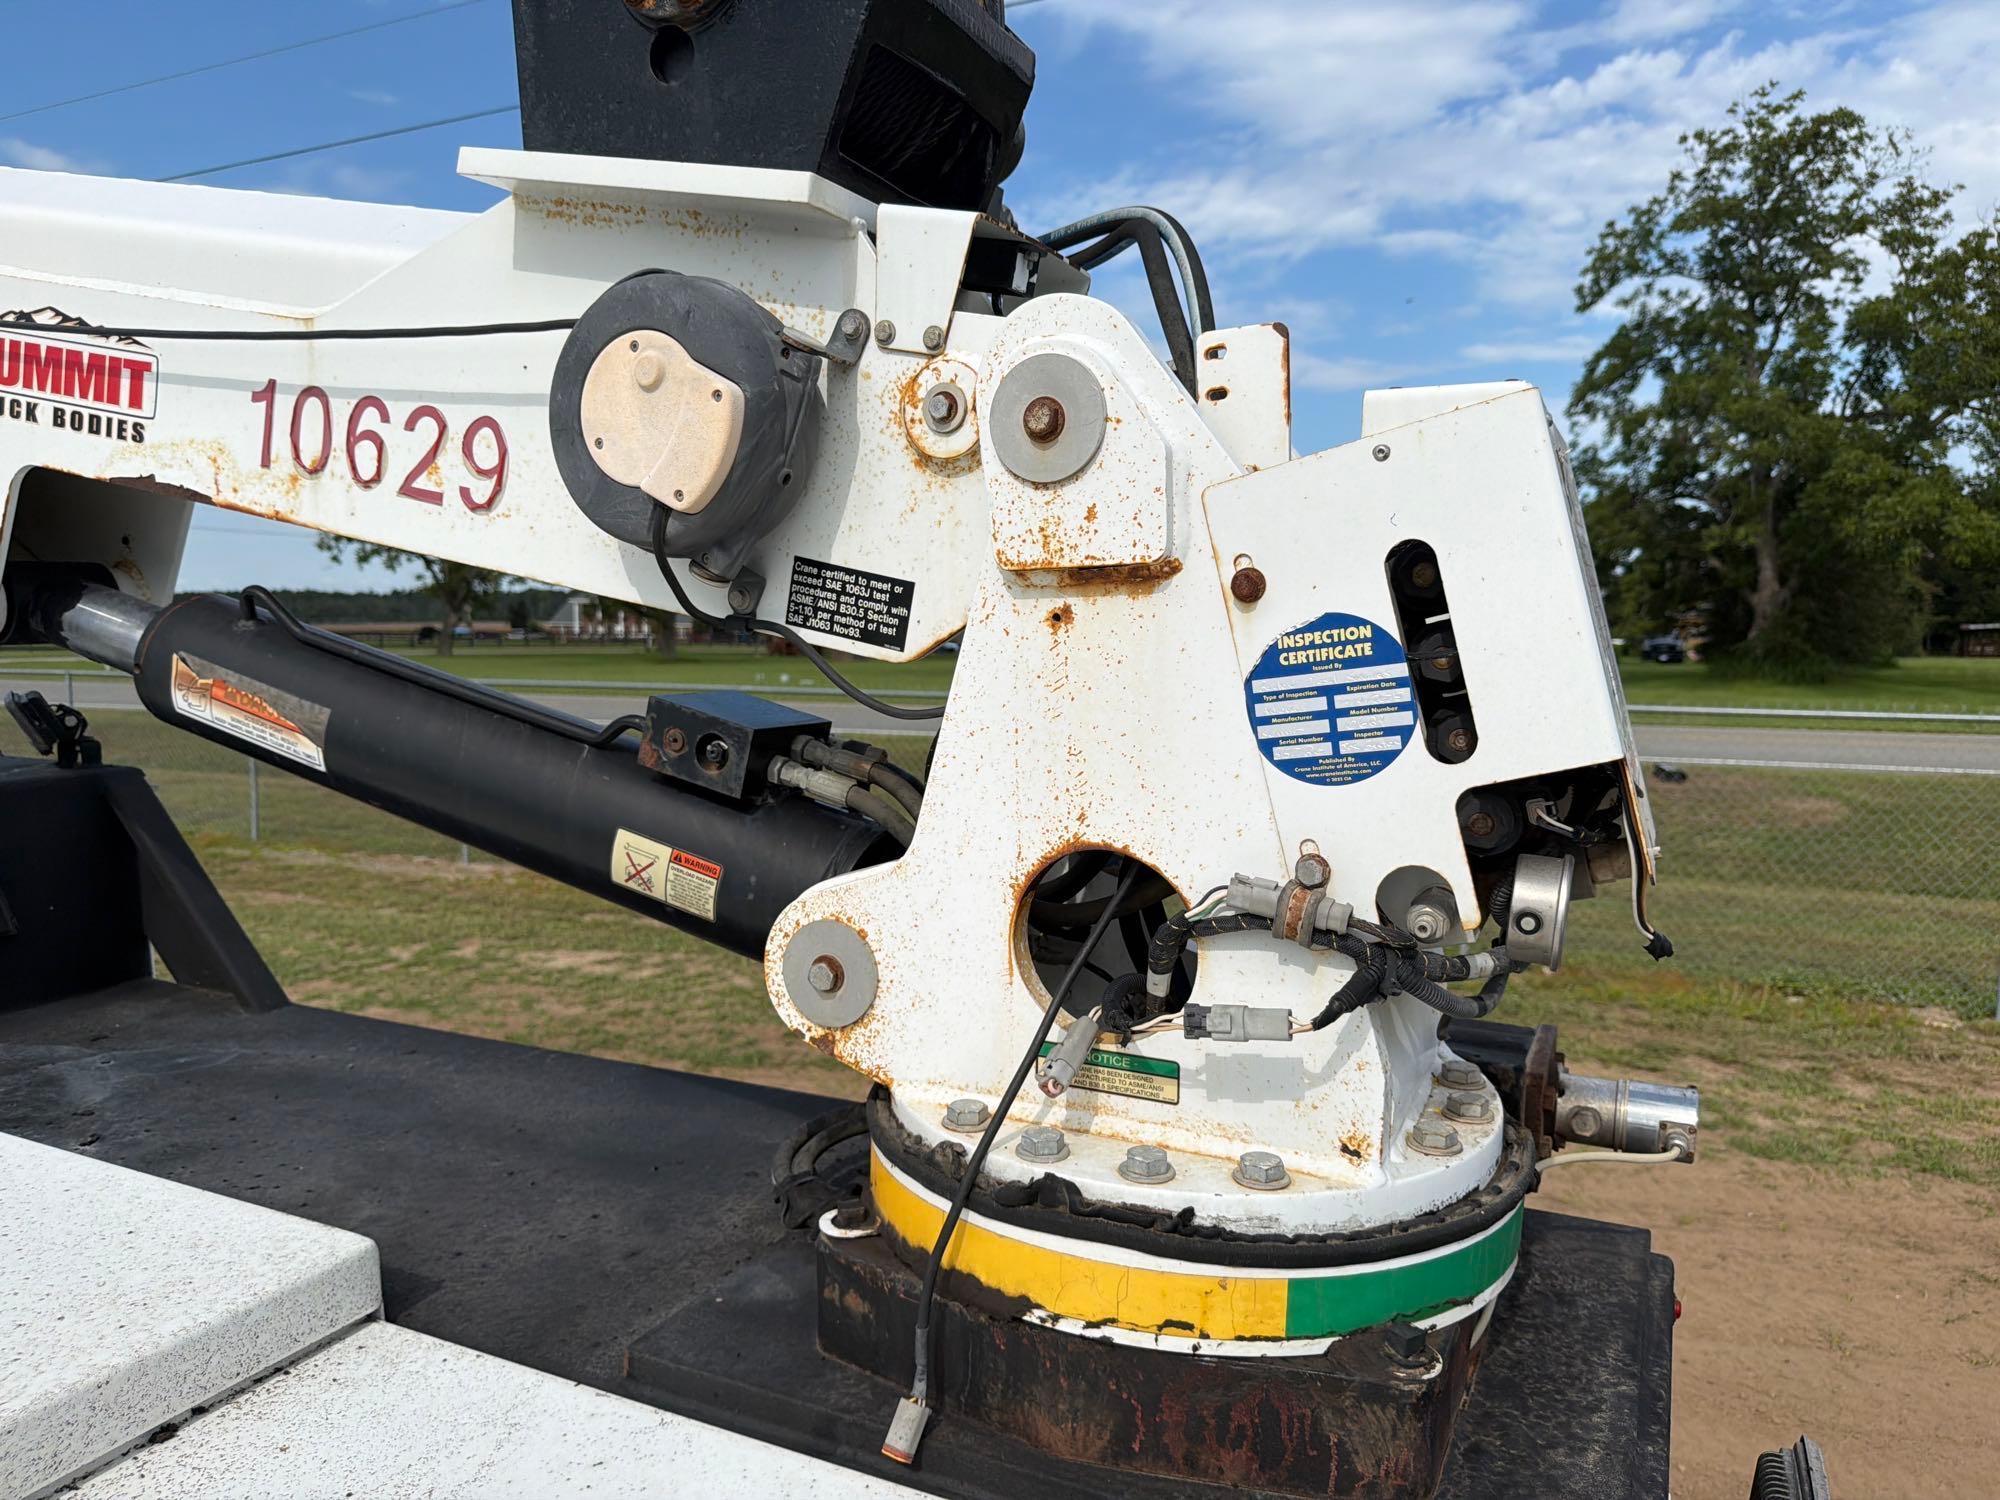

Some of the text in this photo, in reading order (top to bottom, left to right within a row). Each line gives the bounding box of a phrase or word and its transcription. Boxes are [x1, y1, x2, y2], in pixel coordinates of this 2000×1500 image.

[53, 406, 146, 444] BODIES
[250, 378, 510, 515] 10629
[794, 574, 889, 602] exceed SAE 1063J test
[795, 562, 904, 593] Crane certified to meet or
[790, 593, 899, 625] ASME/ANSI B30.5 Section
[792, 584, 908, 616] procedures and comply with
[788, 614, 862, 638] SAE J1063 Nov93.
[818, 611, 831, 621] per
[834, 614, 864, 628] method
[868, 622, 877, 630] of
[880, 624, 896, 636] test
[1277, 625, 1372, 649] INSPECTION
[1279, 643, 1372, 665] CERTIFICATE
[1286, 690, 1317, 699] Inspection
[1347, 683, 1379, 692] Expiration
[1272, 715, 1312, 723] Manufacturer
[1354, 730, 1383, 738] Inspector
[684, 857, 718, 876] WARNING
[1107, 1070, 1122, 1078] BEEN
[1124, 1072, 1153, 1082] DESIGNED
[1128, 1081, 1164, 1092] ASME/ANSI
[1107, 1084, 1161, 1099] SPECIFICATIONS
